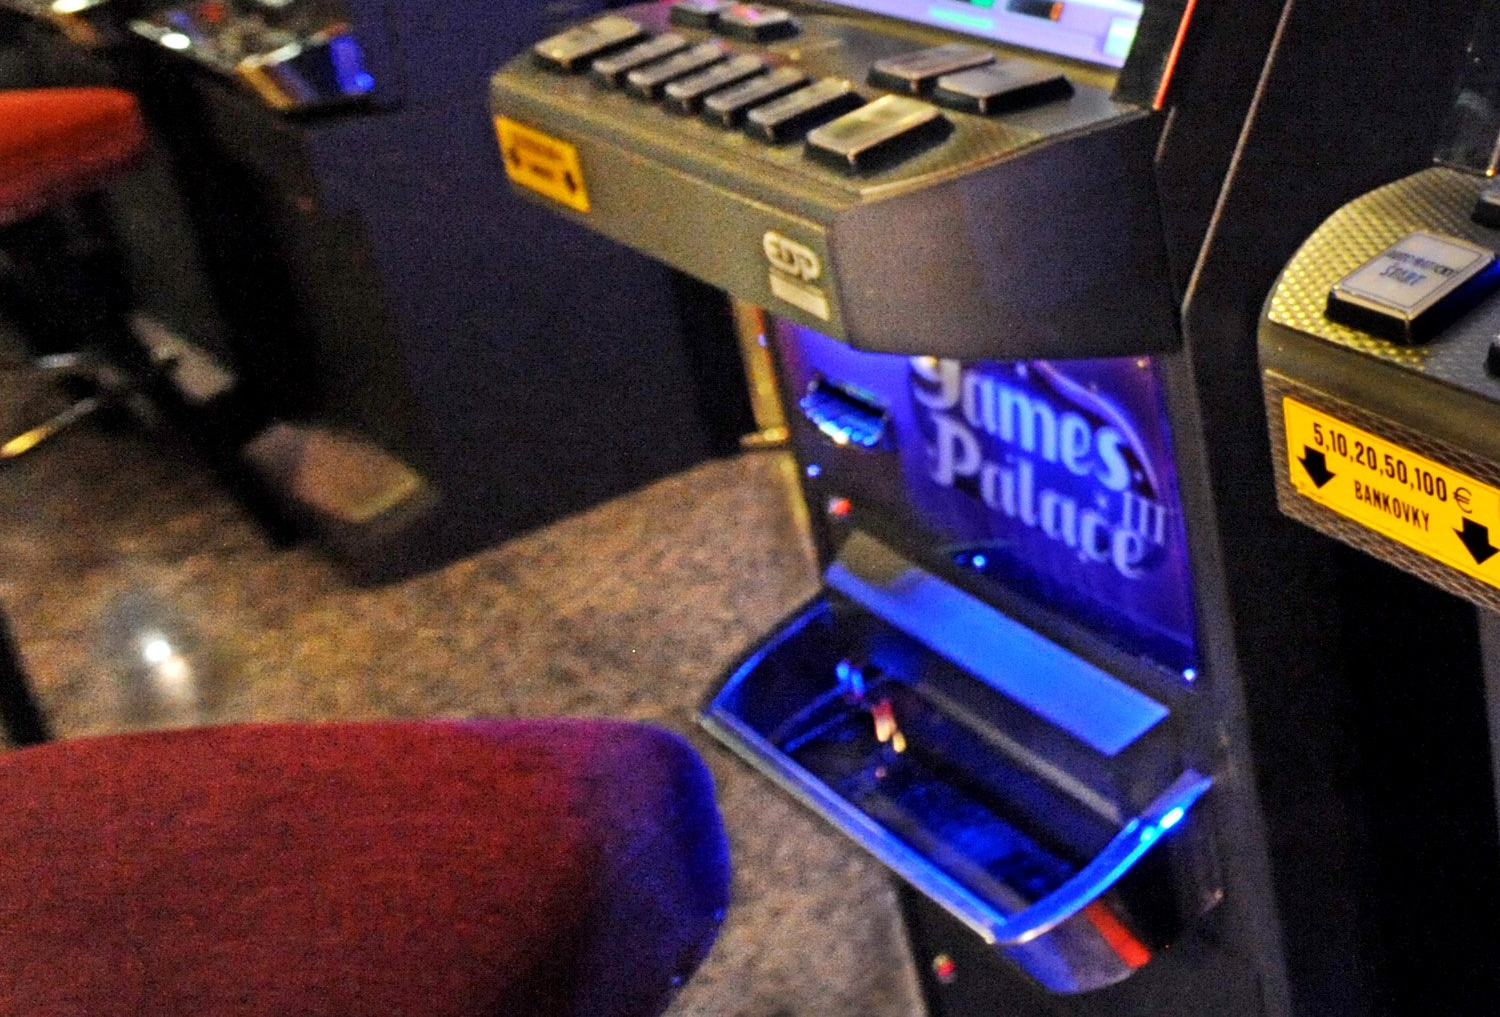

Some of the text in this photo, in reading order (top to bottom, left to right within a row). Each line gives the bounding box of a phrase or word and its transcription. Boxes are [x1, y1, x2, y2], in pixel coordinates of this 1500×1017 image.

[930, 411, 1148, 580] Palace
[1313, 422, 1474, 514] 5,10,20,50,100 €
[1353, 480, 1430, 533] BANKOVKY
